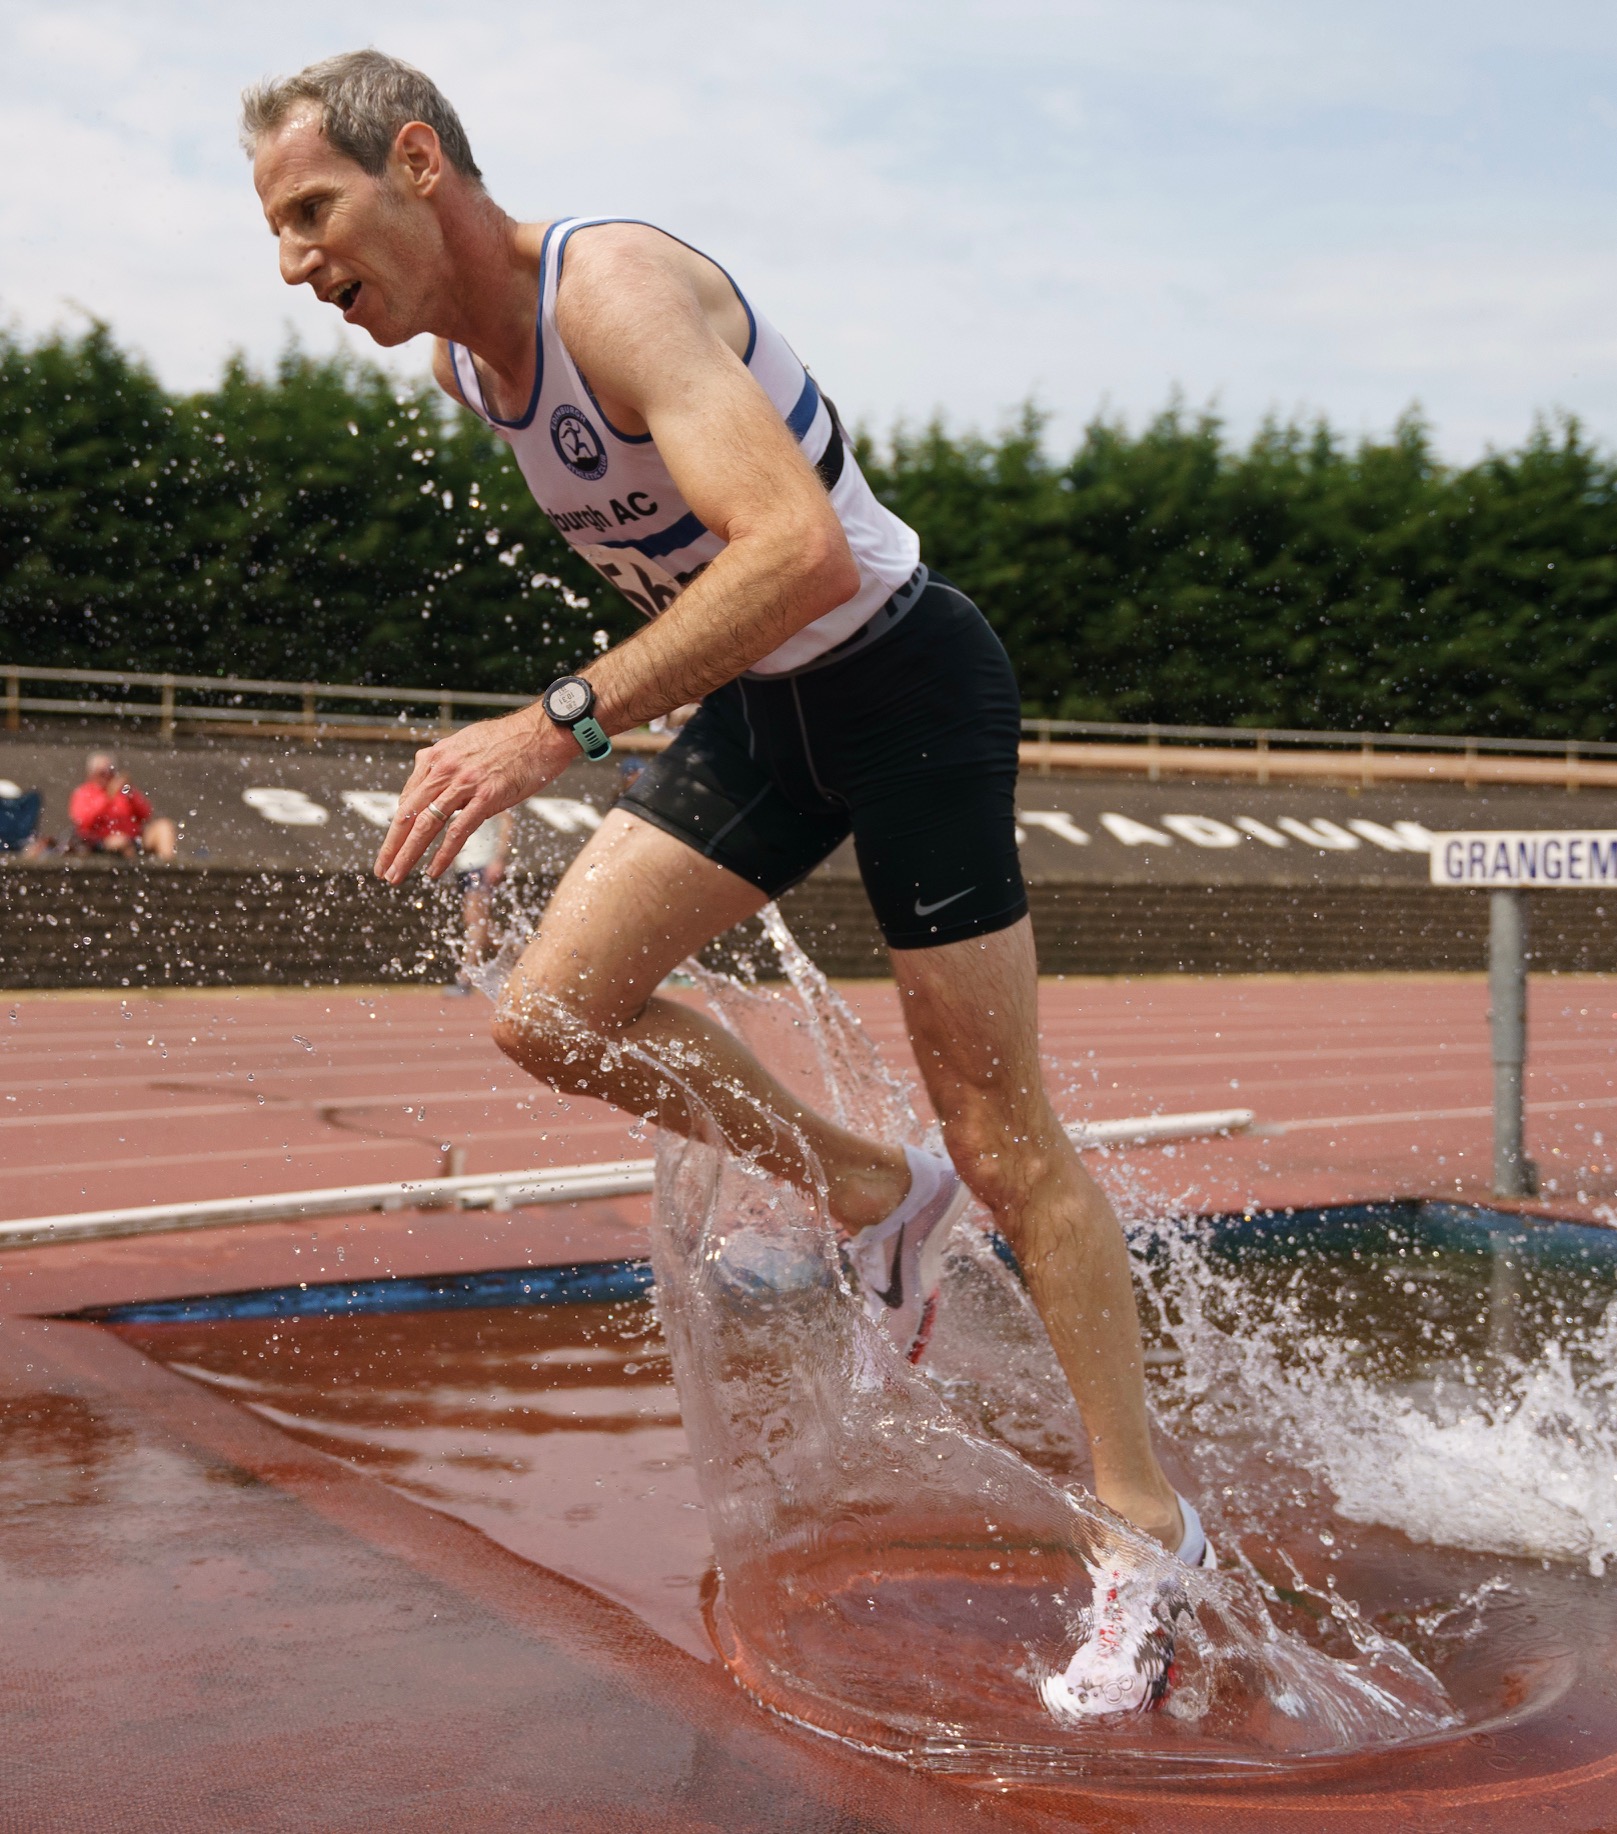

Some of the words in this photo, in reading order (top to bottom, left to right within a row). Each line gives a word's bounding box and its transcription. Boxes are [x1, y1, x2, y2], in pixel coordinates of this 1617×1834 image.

[551, 405, 587, 431] EDINBURGH
[545, 504, 613, 533] burgh
[609, 491, 658, 525] AC
[1015, 811, 1433, 853] TADIUM
[1446, 839, 1617, 879] GRANGEM
